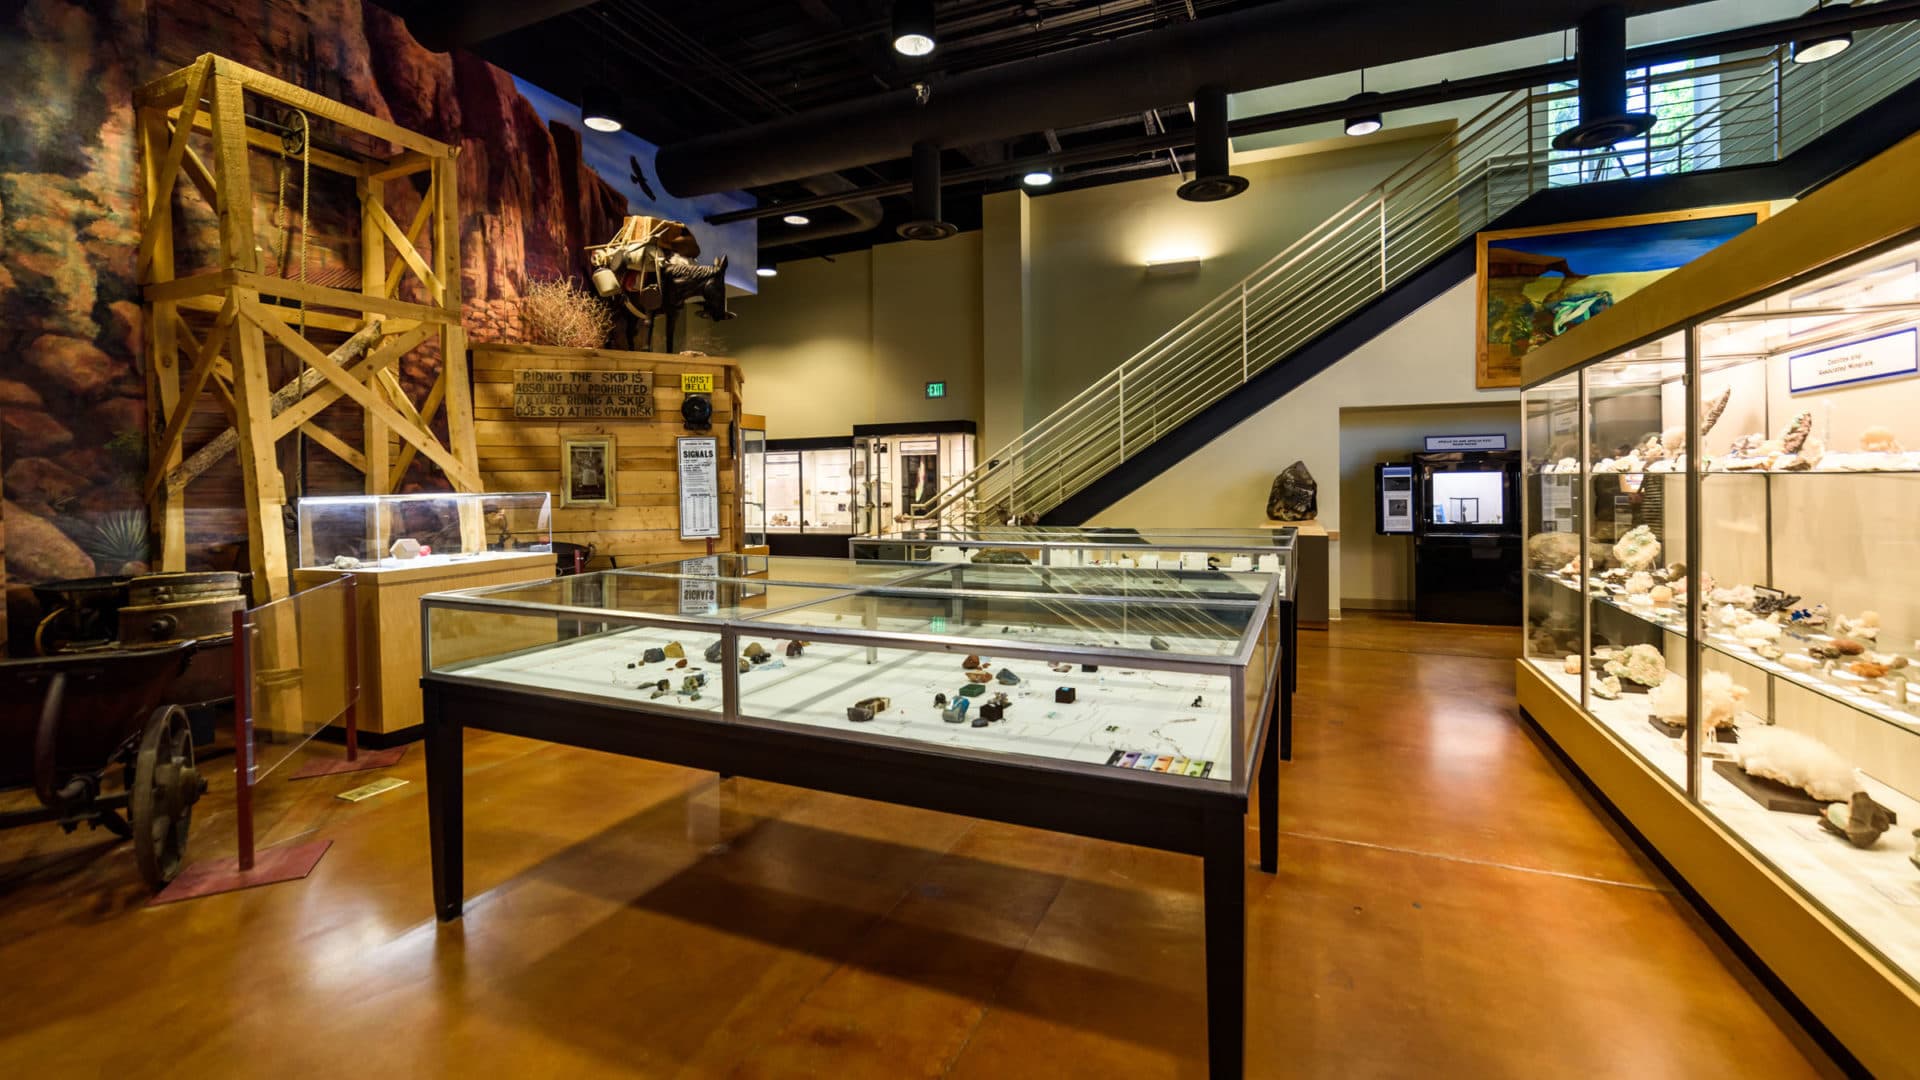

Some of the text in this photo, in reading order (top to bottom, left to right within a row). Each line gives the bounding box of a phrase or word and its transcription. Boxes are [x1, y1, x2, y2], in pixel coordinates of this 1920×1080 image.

[524, 372, 643, 383] RIDING THE SKIP IS
[685, 375, 709, 383] HOIST
[515, 383, 648, 394] ABSOLUTELY PROHIBITED
[929, 383, 943, 396] EXIT
[517, 395, 645, 406] ANYONE RIDING A SKIP
[515, 406, 545, 416] DOES
[550, 406, 565, 416] SO
[568, 407, 581, 416] AT
[585, 407, 601, 416] HIS
[604, 407, 628, 416] OWN
[683, 450, 714, 458] SIGNALS
